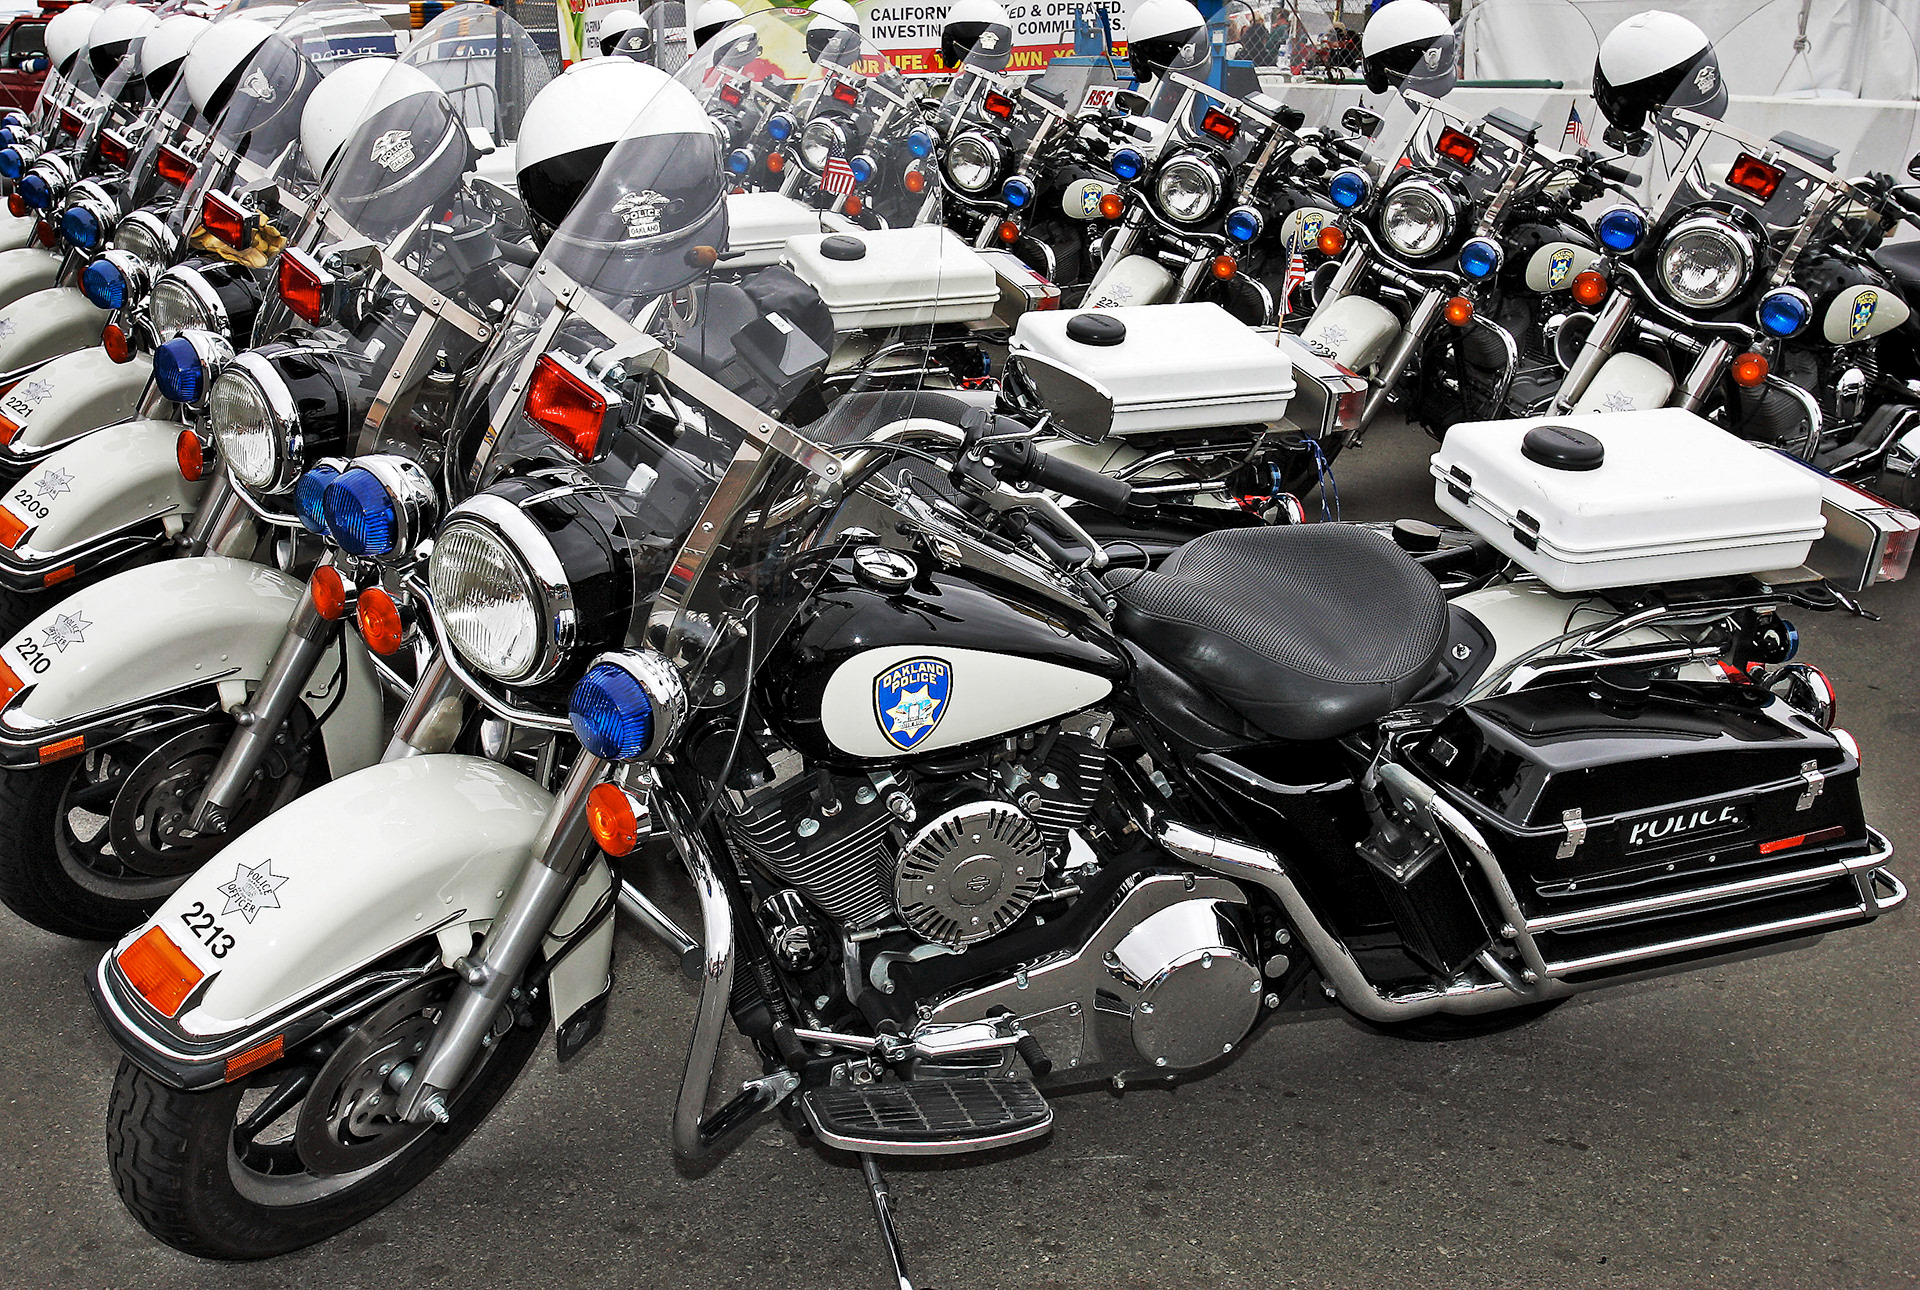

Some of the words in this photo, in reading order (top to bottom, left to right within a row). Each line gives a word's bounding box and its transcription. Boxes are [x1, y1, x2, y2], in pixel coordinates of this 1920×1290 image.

[870, 6, 950, 22] CALIFORN
[871, 24, 942, 39] INVESTIN
[622, 208, 661, 224] POLICE
[5, 396, 34, 418] 2221
[14, 489, 49, 519] 2209
[15, 637, 51, 674] 2210
[883, 662, 944, 688] OAKLAND
[891, 672, 937, 694] POLICE
[246, 870, 273, 896] POLICE
[227, 883, 256, 914] OFFICER
[180, 901, 236, 959] 2213
